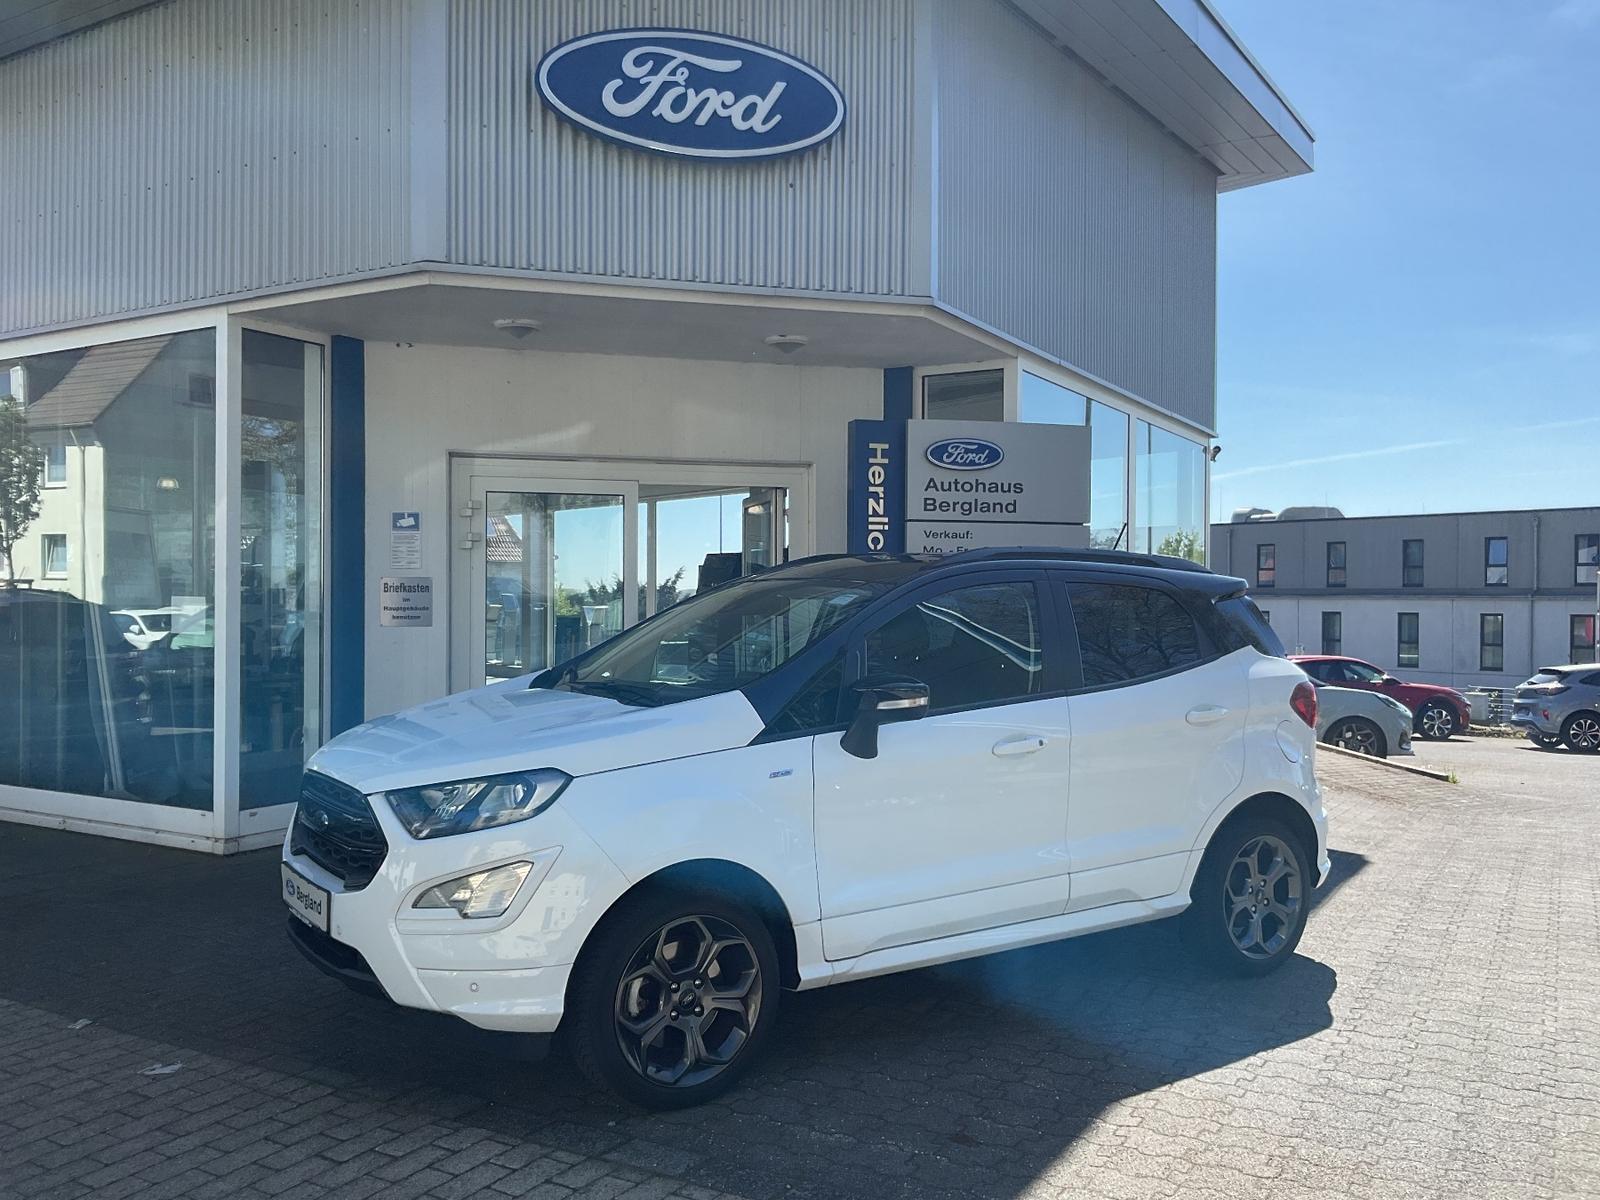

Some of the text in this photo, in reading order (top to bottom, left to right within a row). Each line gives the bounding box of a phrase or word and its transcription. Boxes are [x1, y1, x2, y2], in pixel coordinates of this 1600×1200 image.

[602, 46, 787, 133] Ford
[942, 443, 989, 464] Ford
[924, 477, 1024, 494] Autohaus
[867, 442, 889, 553] Herzlic
[923, 497, 1017, 516] Bergland
[923, 530, 973, 539] Verkauf:
[383, 582, 430, 593] Briefkasten
[296, 885, 322, 915] Bergland
